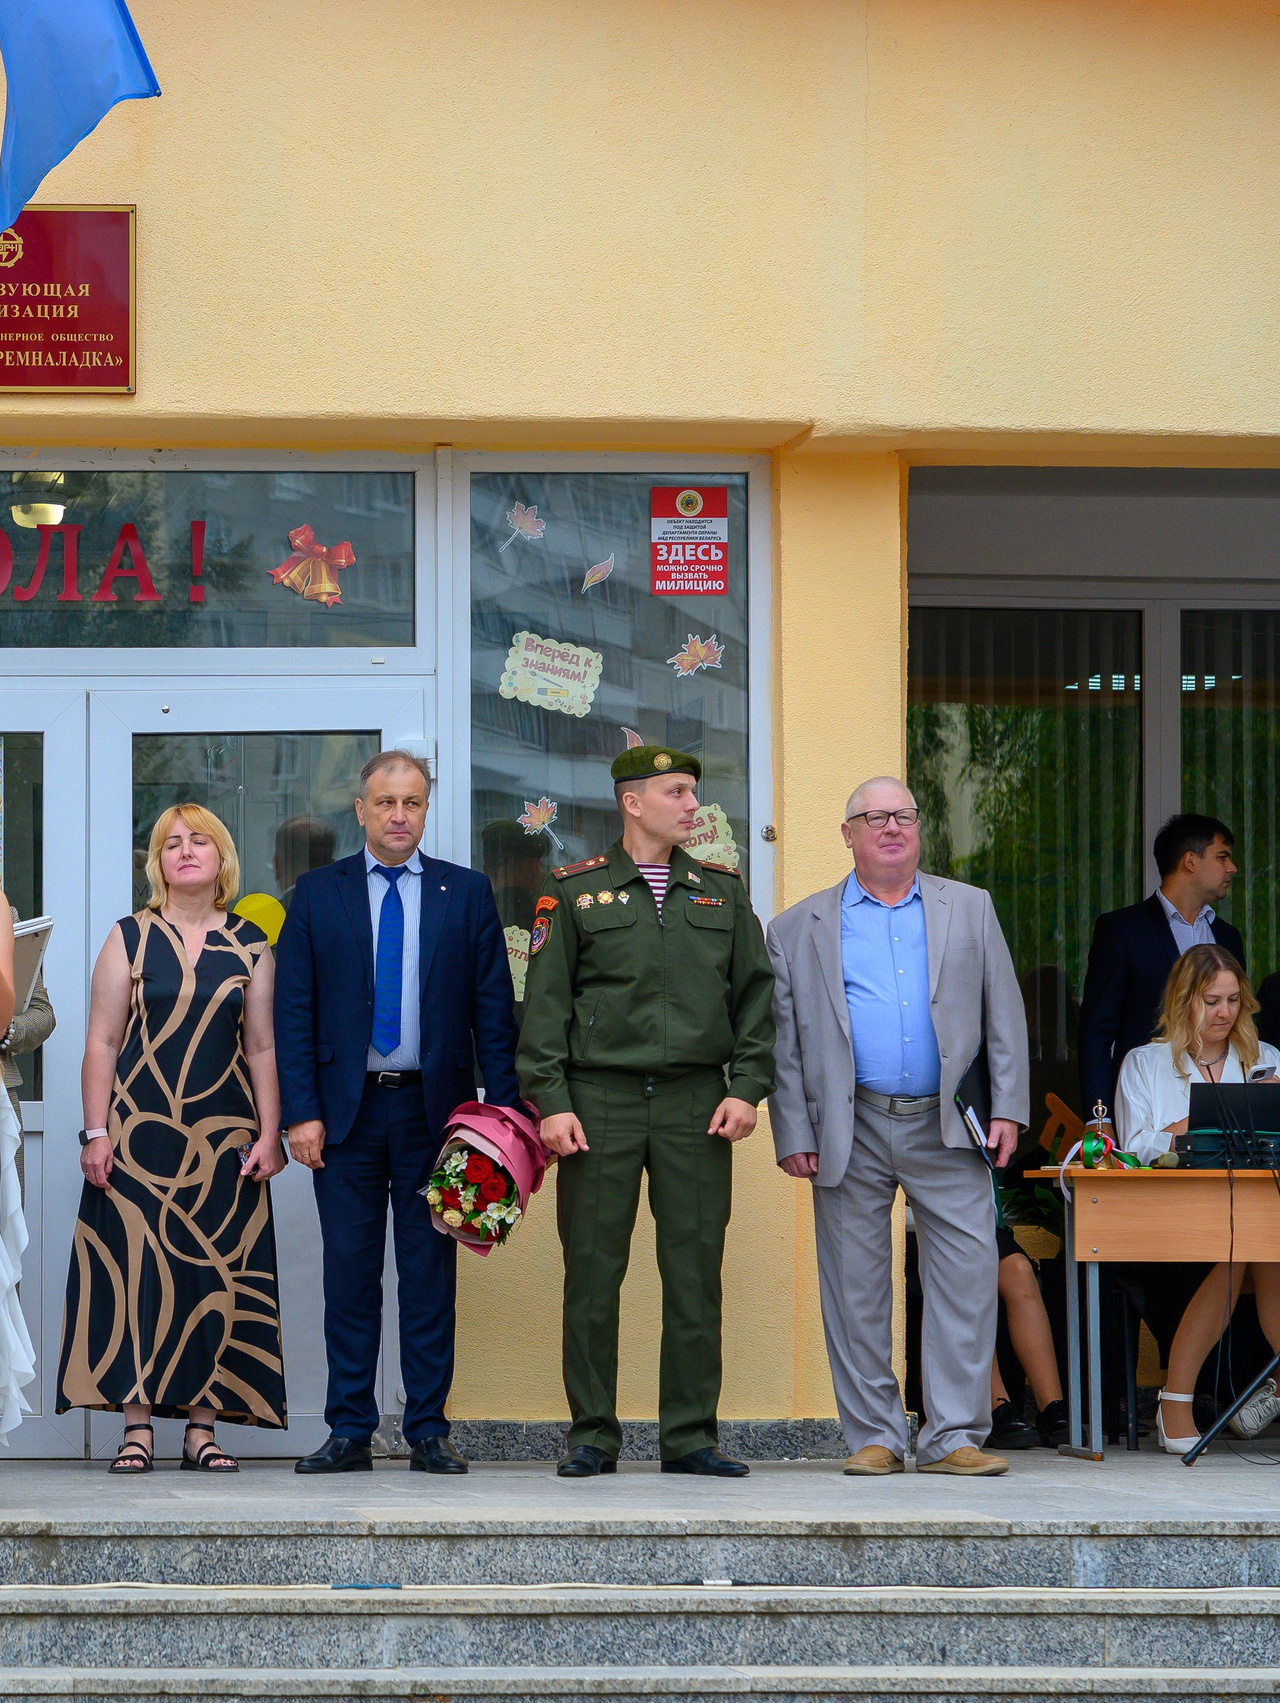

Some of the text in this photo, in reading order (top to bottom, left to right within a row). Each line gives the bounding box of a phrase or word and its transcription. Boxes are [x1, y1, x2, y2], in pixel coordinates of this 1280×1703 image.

[51, 333, 114, 343] ОБЩЕСТВО
[657, 544, 723, 564] ЗДЕСЬ
[655, 580, 724, 592] МИЛИЦИЮ
[524, 637, 593, 668] Вперёд к
[522, 657, 588, 684] знаниям!
[682, 825, 719, 850] колу!
